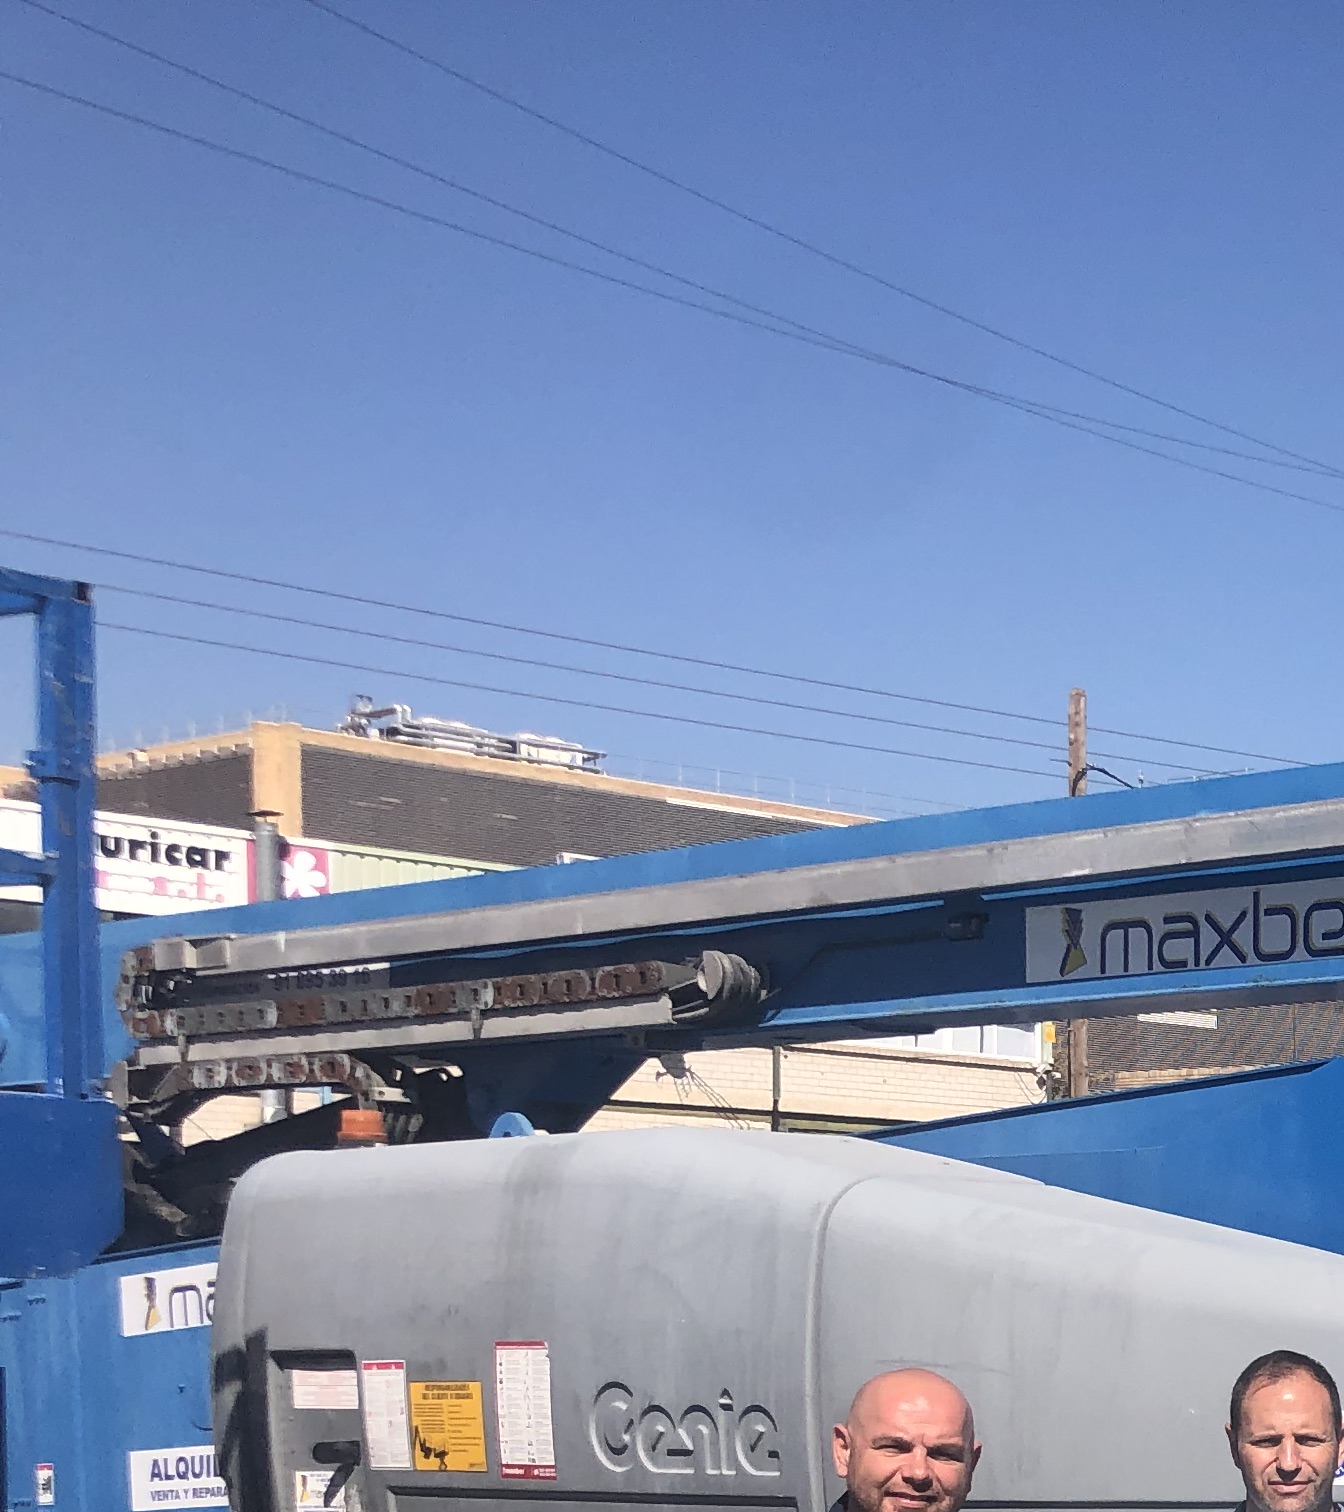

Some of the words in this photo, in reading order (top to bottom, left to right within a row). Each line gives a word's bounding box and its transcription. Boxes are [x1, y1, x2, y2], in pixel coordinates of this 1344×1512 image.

[99, 831, 232, 871] uricar
[589, 1381, 781, 1475] Genie
[150, 1489, 181, 1501] VENTA
[183, 1488, 190, 1499] Y
